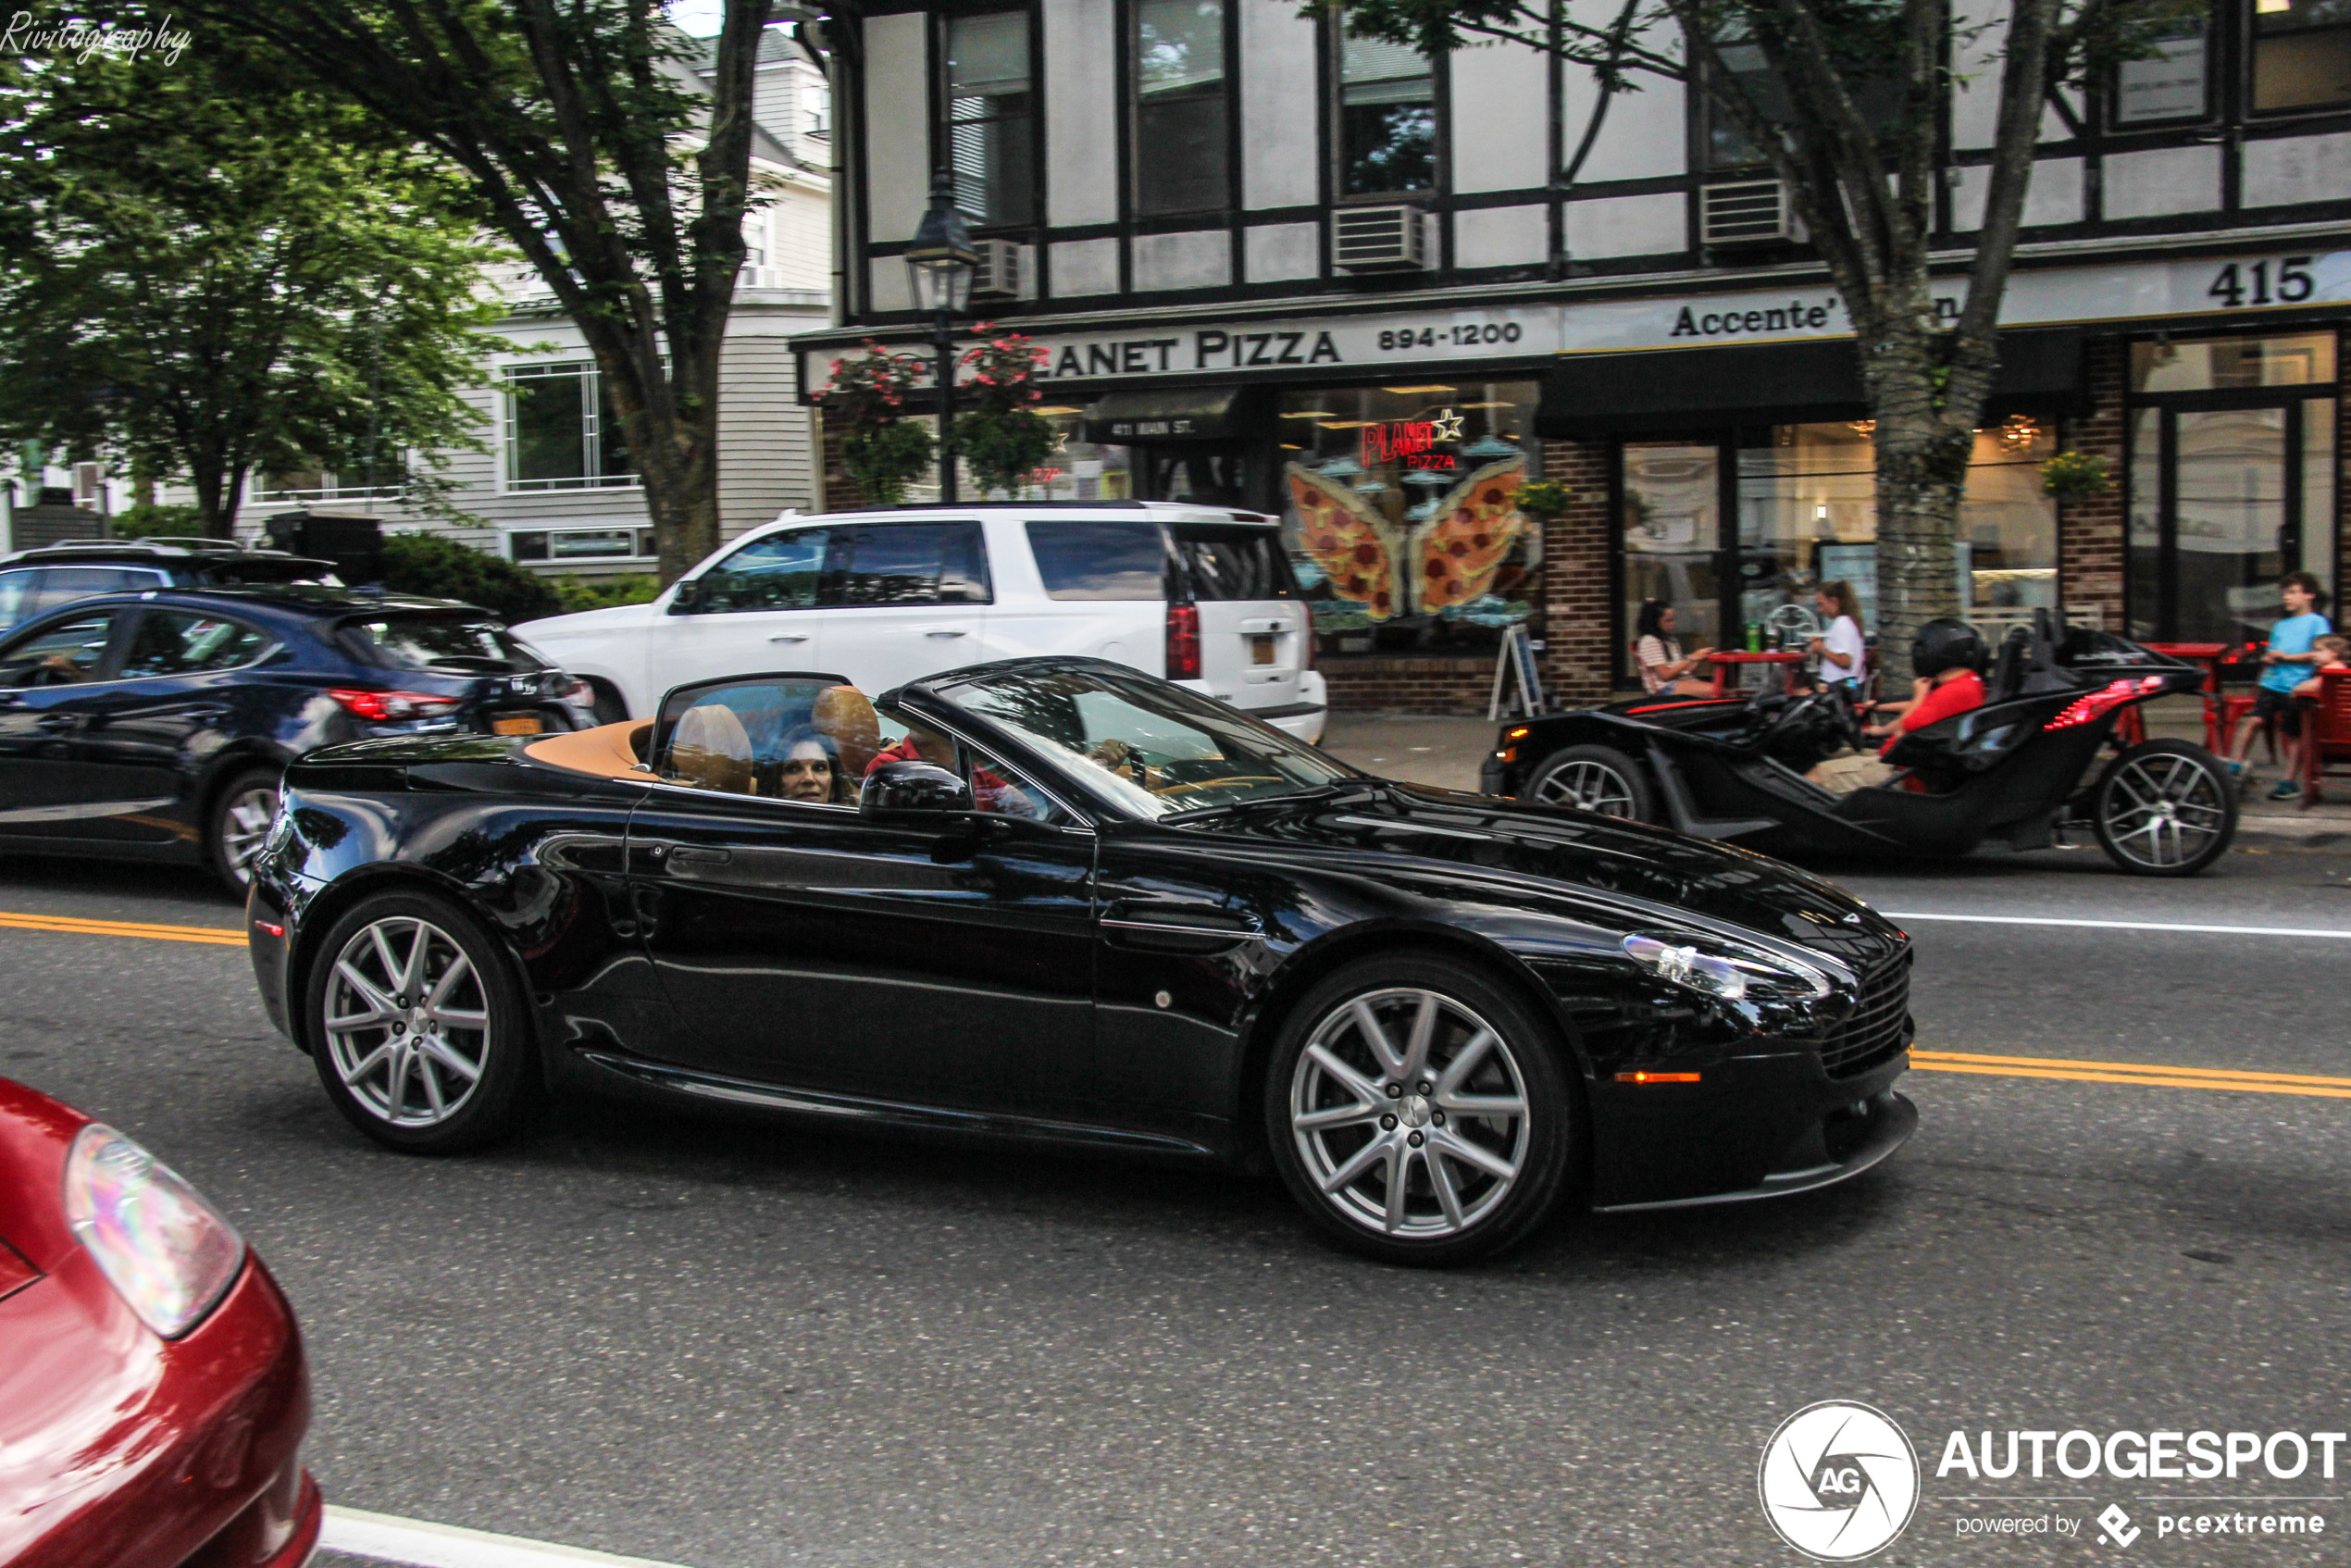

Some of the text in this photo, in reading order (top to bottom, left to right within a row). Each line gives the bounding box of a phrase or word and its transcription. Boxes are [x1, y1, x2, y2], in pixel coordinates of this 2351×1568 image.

[2208, 255, 2315, 306] 415
[1378, 322, 1523, 351] 894-1200
[1669, 296, 1839, 337] Accente'
[1362, 421, 1435, 467] PLANET
[1407, 454, 1456, 469] PIZZA
